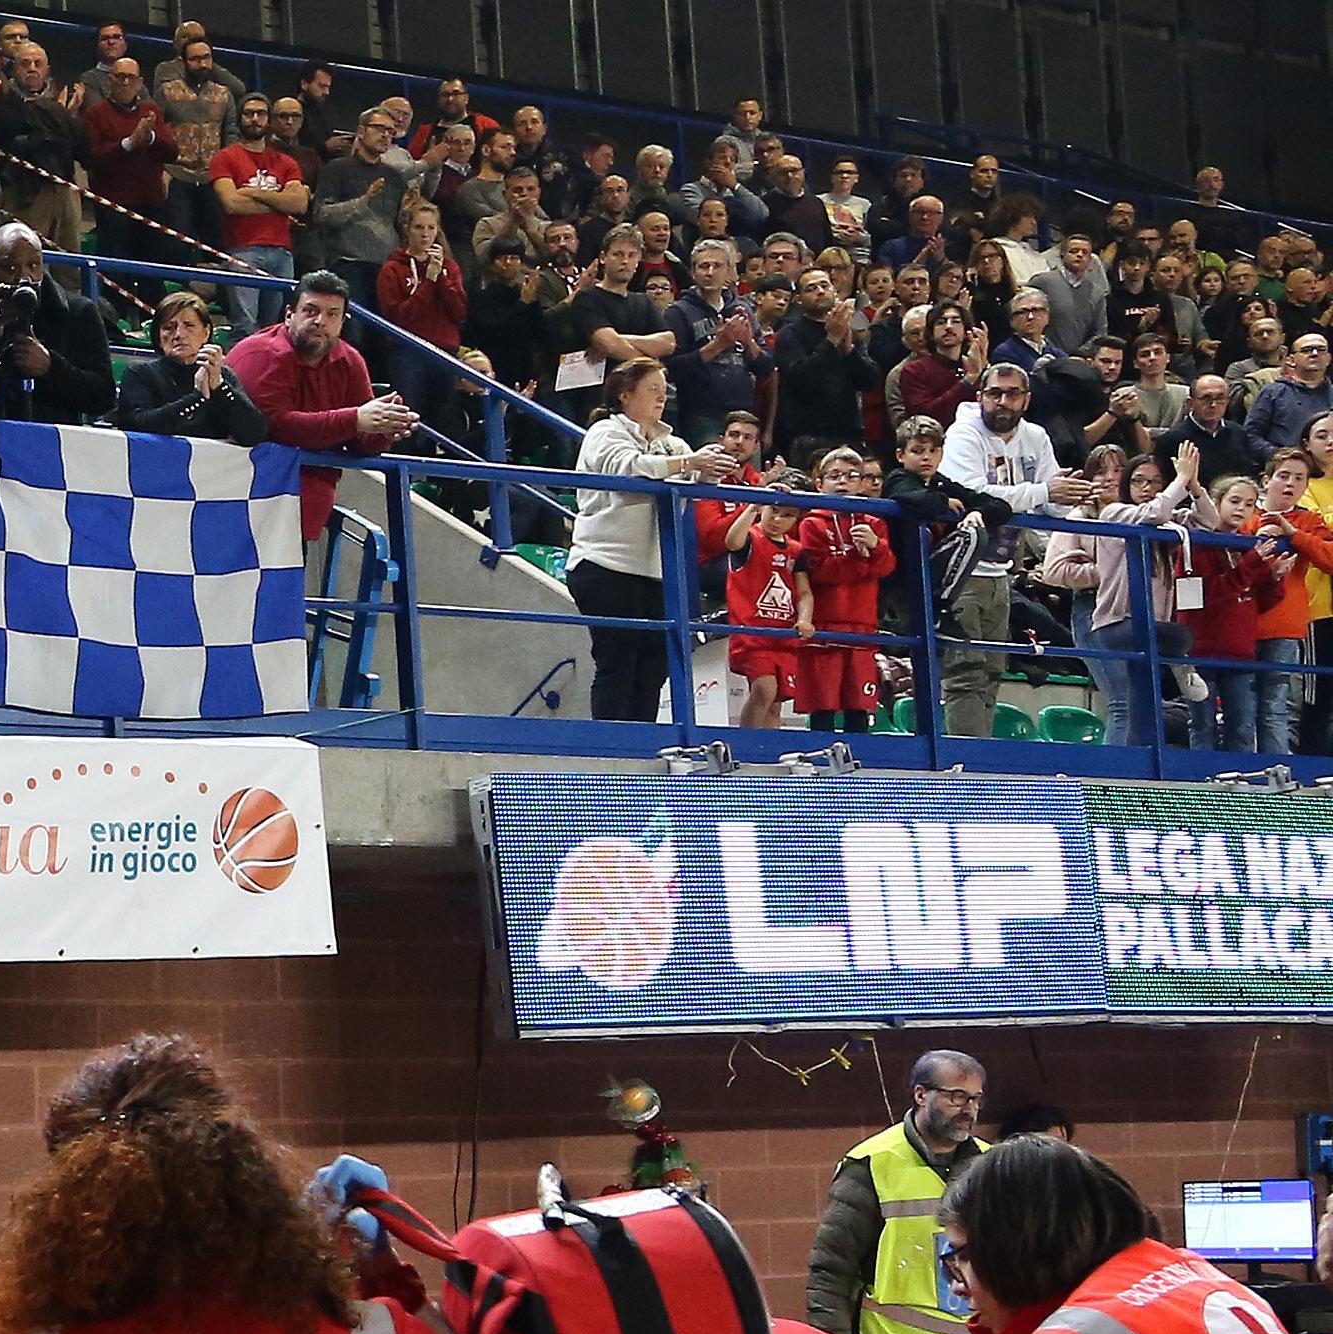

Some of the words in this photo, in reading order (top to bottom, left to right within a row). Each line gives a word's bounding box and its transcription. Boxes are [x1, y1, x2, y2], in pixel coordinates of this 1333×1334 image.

[89, 815, 199, 850] energie
[90, 844, 116, 873] in
[122, 844, 199, 881] gioco
[1094, 825, 1240, 895] LEGA
[717, 820, 1069, 974] LNP
